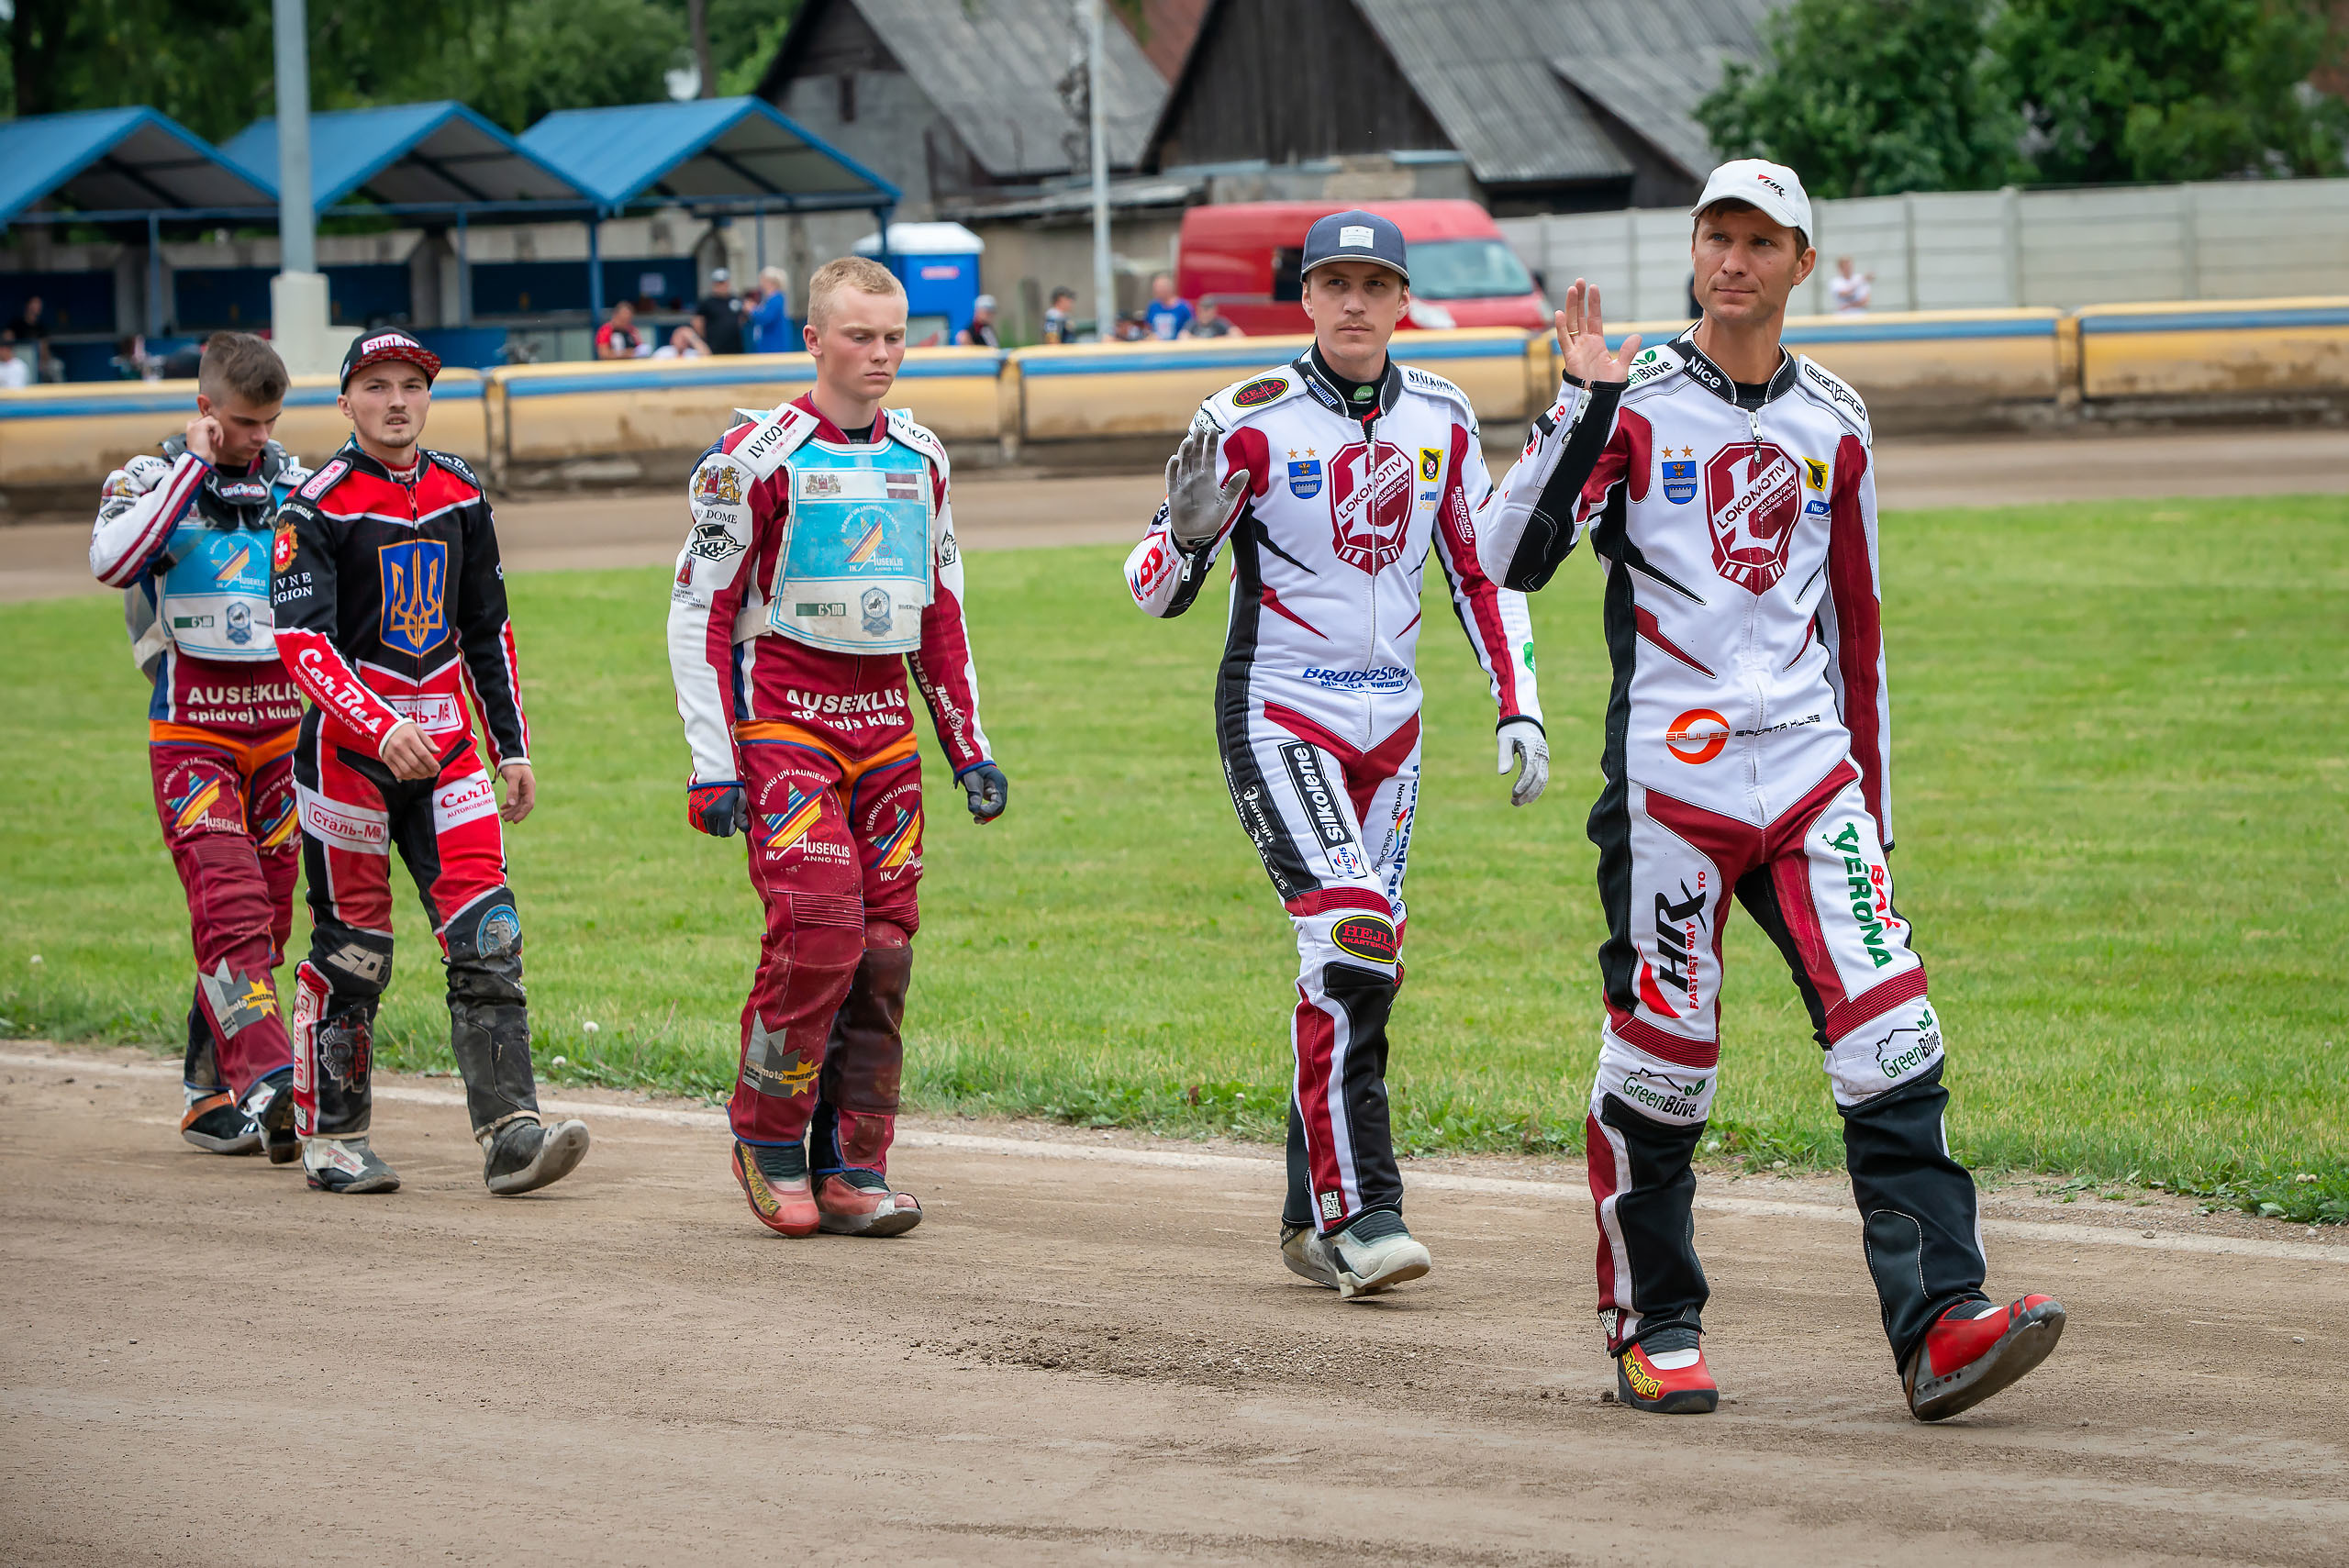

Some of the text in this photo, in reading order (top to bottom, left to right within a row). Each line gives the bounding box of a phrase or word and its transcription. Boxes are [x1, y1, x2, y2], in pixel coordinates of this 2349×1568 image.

[1628, 360, 1674, 384] enBūve
[1686, 356, 1721, 389] Nice
[1239, 380, 1283, 402] HEJLA
[1554, 405, 1565, 422] TO
[1717, 461, 1787, 529] LOKOMOTIV
[1757, 480, 1795, 514] DAUGAVPILS
[706, 509, 738, 525] DOME
[1454, 485, 1475, 539] BRODDSON
[818, 604, 844, 616] CSDD
[186, 683, 301, 706] AUSEKLIS
[786, 689, 906, 715] AUSEKLIS
[266, 706, 302, 720] klubs
[1665, 730, 1731, 741] SAULES
[777, 769, 790, 780] UN
[1293, 746, 1346, 842] Silkolene
[1391, 783, 1406, 821] Nordsjö
[776, 830, 851, 861] AUSEKLIS
[765, 851, 851, 866] IK ANNO 1989
[1339, 847, 1355, 874] FUCHS
[880, 871, 893, 882] IK
[1342, 924, 1397, 951] HEJLA
[1687, 871, 1707, 1011] FASTEST WAY TO
